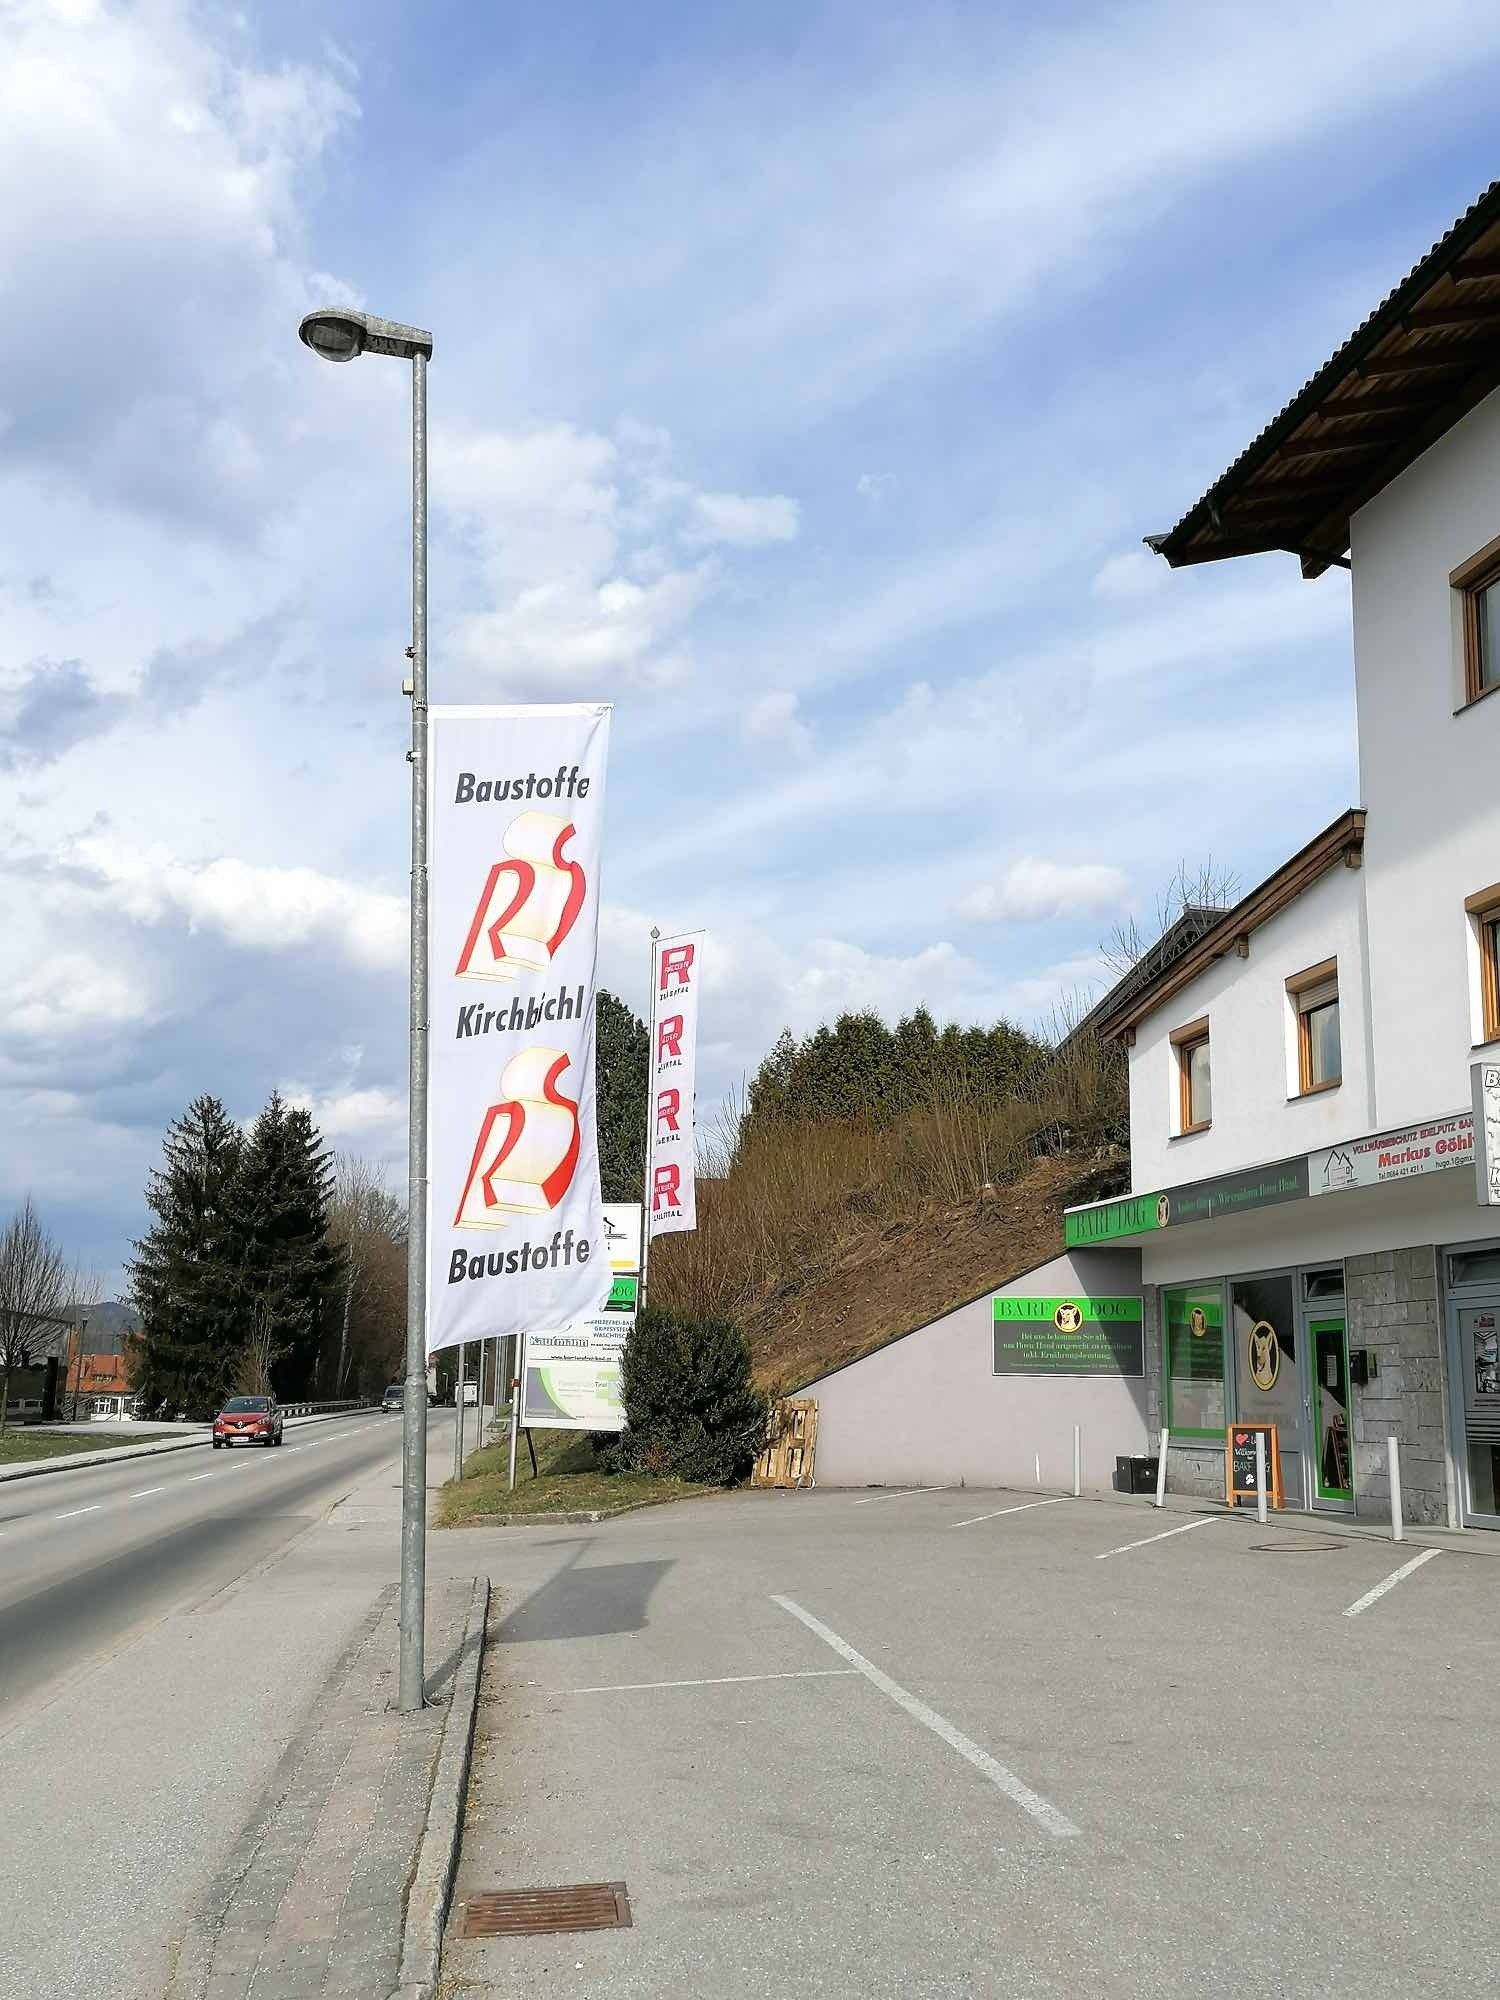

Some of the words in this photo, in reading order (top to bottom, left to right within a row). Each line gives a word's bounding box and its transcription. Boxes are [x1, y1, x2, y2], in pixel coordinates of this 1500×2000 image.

[455, 765, 590, 804] Baustoffe
[1420, 1122, 1457, 1139] EDELPUTZ
[1377, 1146, 1432, 1168] Markus
[1076, 1206, 1111, 1239] BARF
[1118, 1199, 1146, 1231] DOG
[448, 1230, 591, 1285] Baustoffe
[1001, 1301, 1051, 1317] BARF
[1089, 1302, 1127, 1318] DOG
